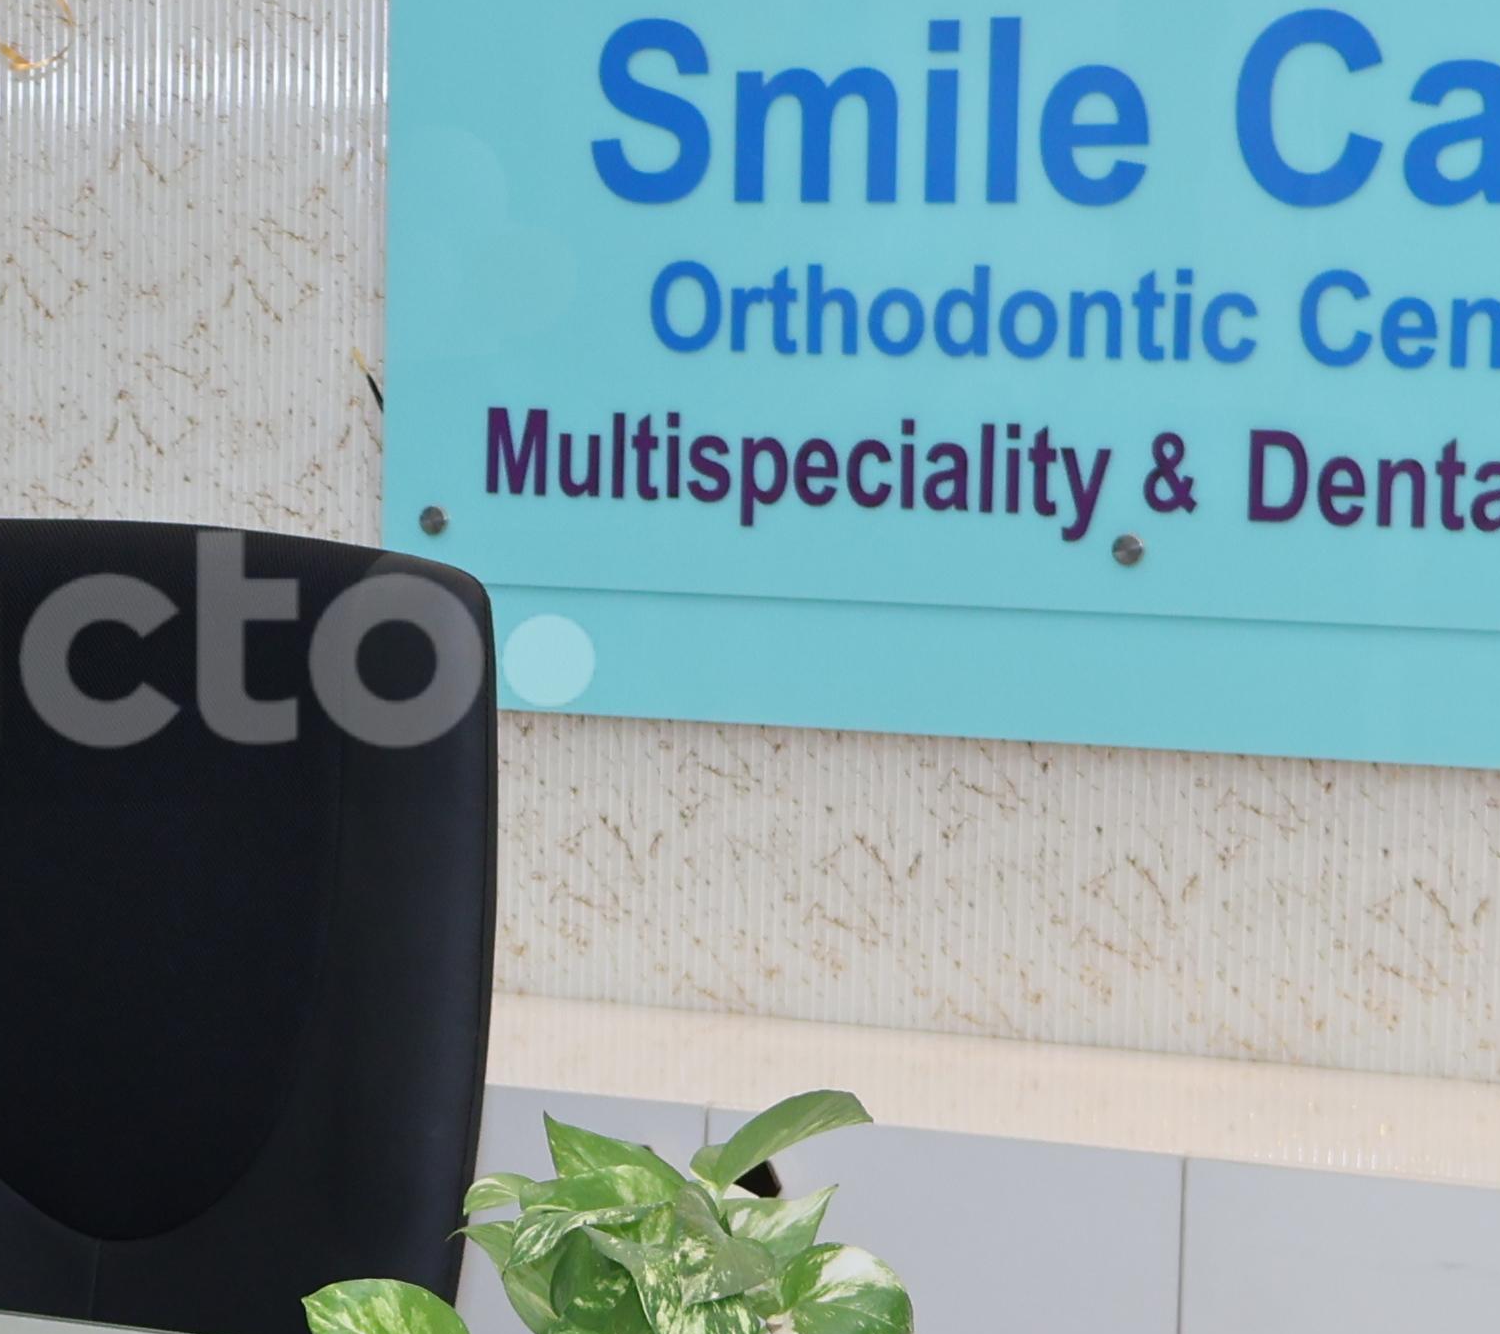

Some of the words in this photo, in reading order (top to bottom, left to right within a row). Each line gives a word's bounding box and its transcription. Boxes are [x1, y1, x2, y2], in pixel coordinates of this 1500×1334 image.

[590, 16, 1150, 207] Smile
[650, 260, 1258, 364] Orthodontic
[485, 406, 1113, 544] Multispeciality
[1142, 430, 1199, 515] &
